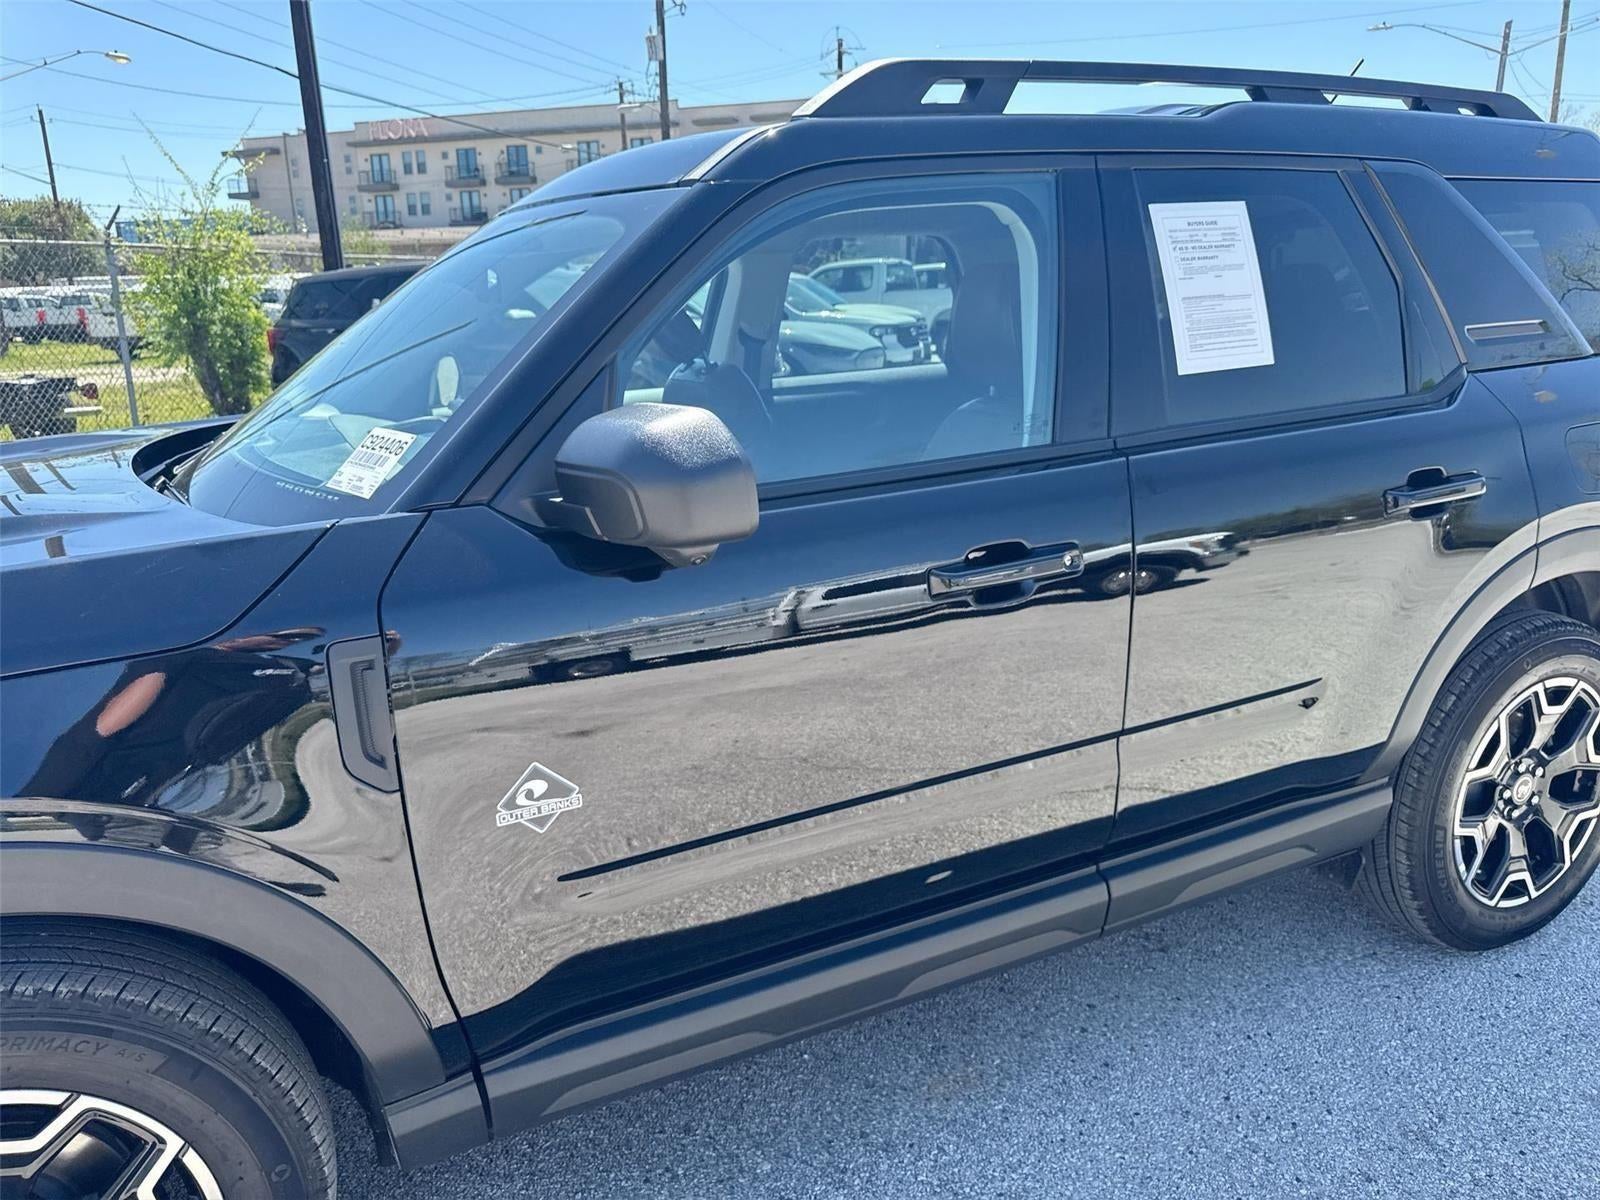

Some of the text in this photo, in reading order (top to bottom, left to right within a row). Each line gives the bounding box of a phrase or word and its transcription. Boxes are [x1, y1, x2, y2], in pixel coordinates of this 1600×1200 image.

[360, 433, 409, 456] C924406
[499, 797, 580, 823] OUTER BANKS
[115, 1048, 147, 1063] A/S
